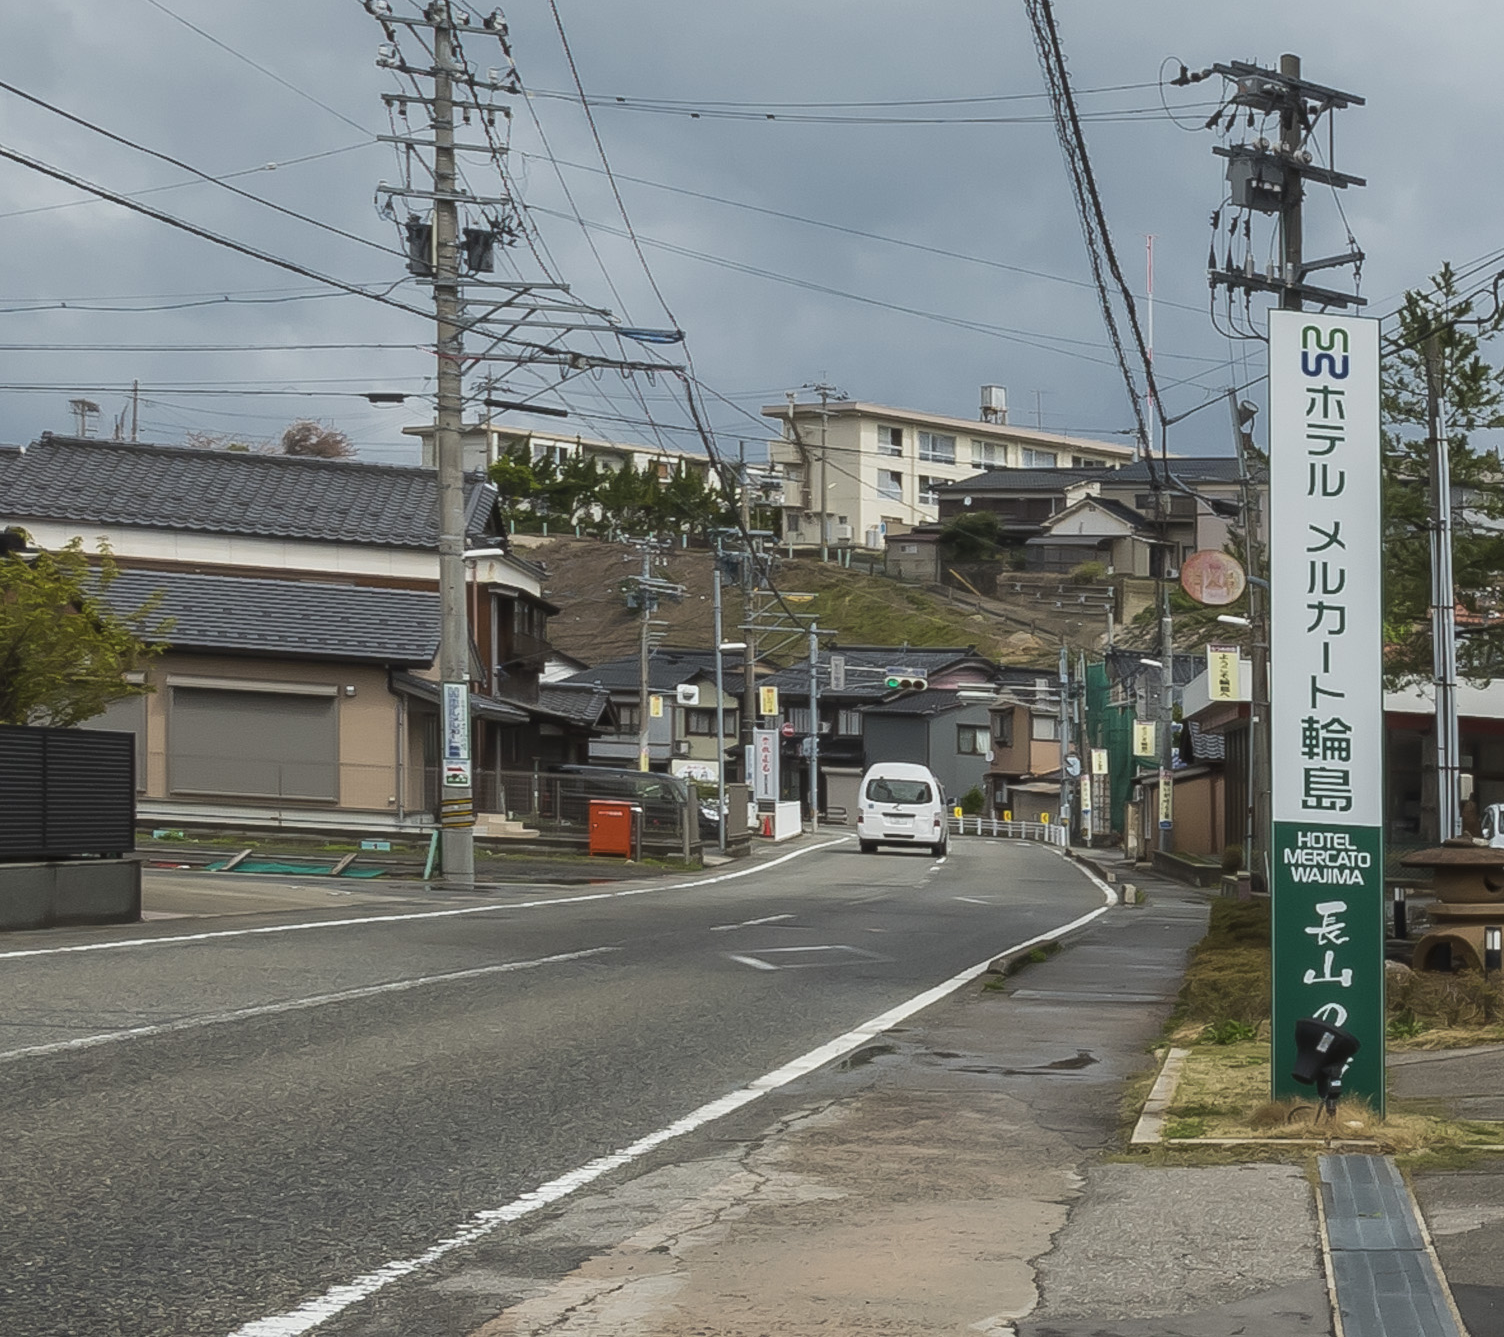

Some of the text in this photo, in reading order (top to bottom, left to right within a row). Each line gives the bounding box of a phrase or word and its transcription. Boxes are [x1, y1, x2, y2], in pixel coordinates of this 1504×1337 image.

[1301, 385, 1353, 813] ホテル メルカート輪島
[1297, 830, 1358, 850] HOTEL
[1283, 847, 1371, 868] MERCATO
[1290, 865, 1365, 886] WAJIMA
